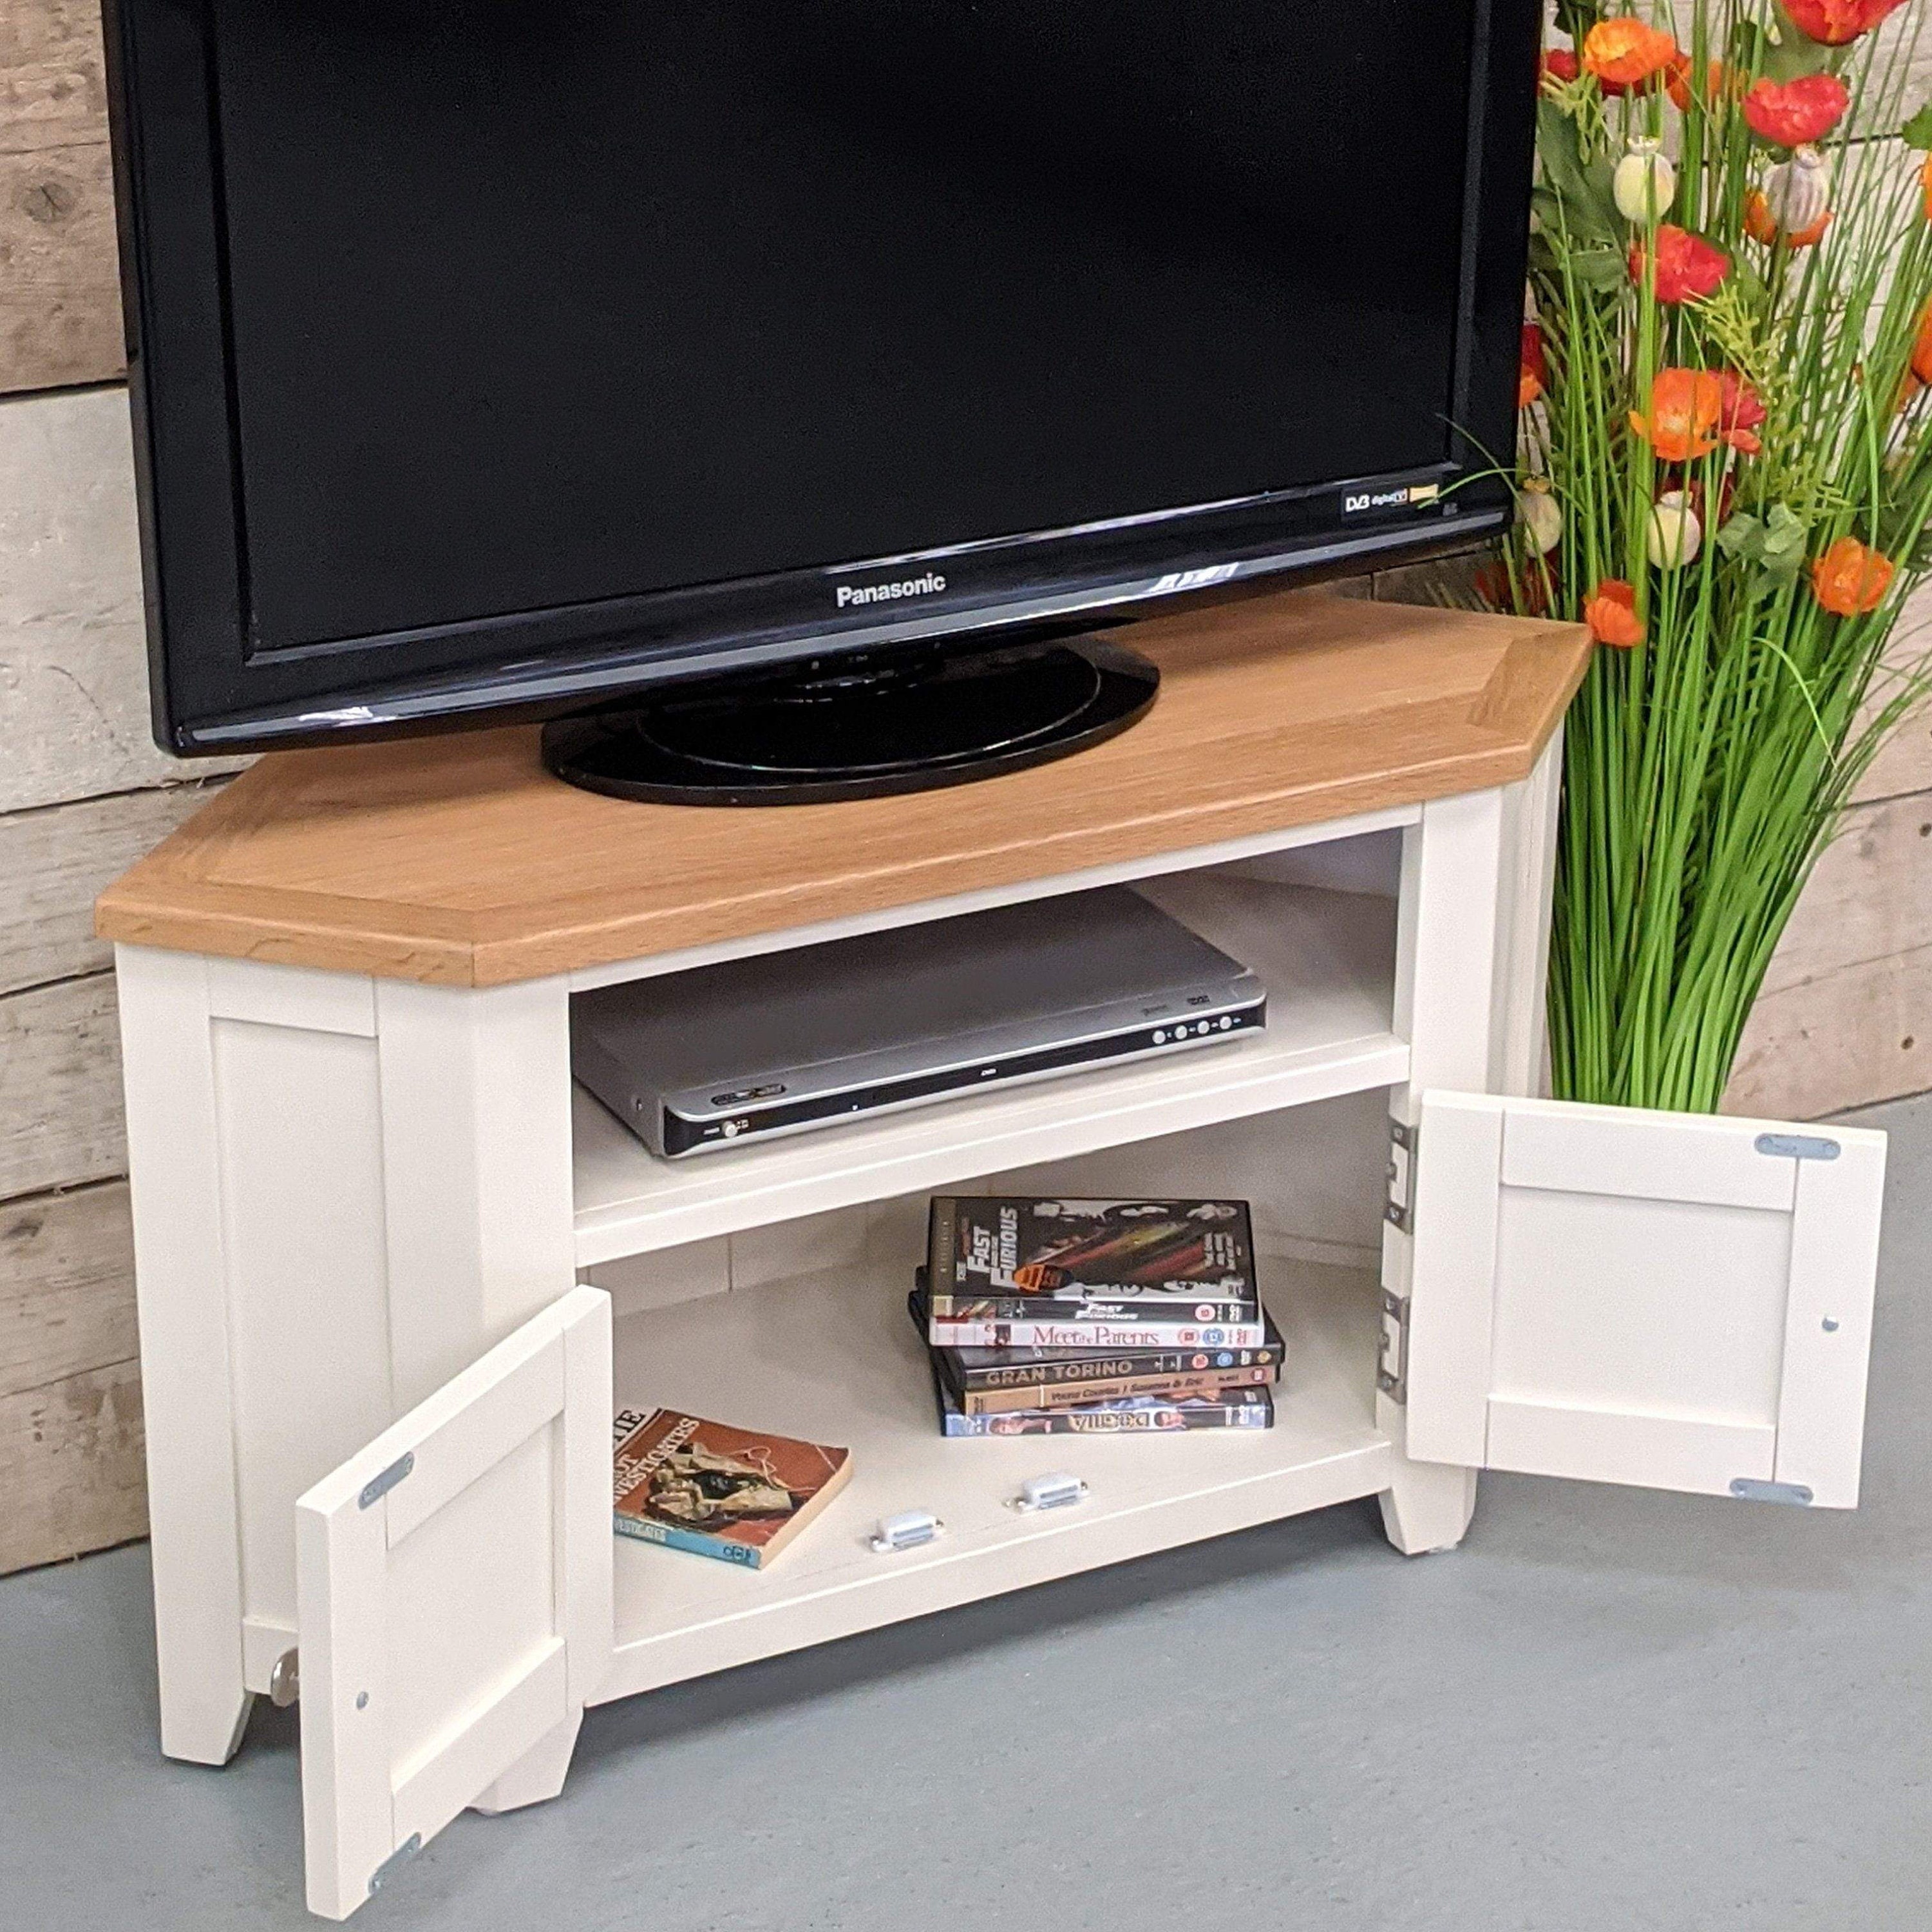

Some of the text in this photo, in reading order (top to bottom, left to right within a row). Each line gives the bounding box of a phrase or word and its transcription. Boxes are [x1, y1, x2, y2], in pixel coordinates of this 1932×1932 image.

[1345, 494, 1370, 513] DVB
[837, 572, 947, 608] Panasonic
[967, 1226, 991, 1274] FAST
[990, 1206, 1019, 1289] FURIOUS
[1033, 1325, 1079, 1345] Meet
[1095, 1325, 1159, 1345] Parents
[986, 1360, 1133, 1385] GRAN TORINO
